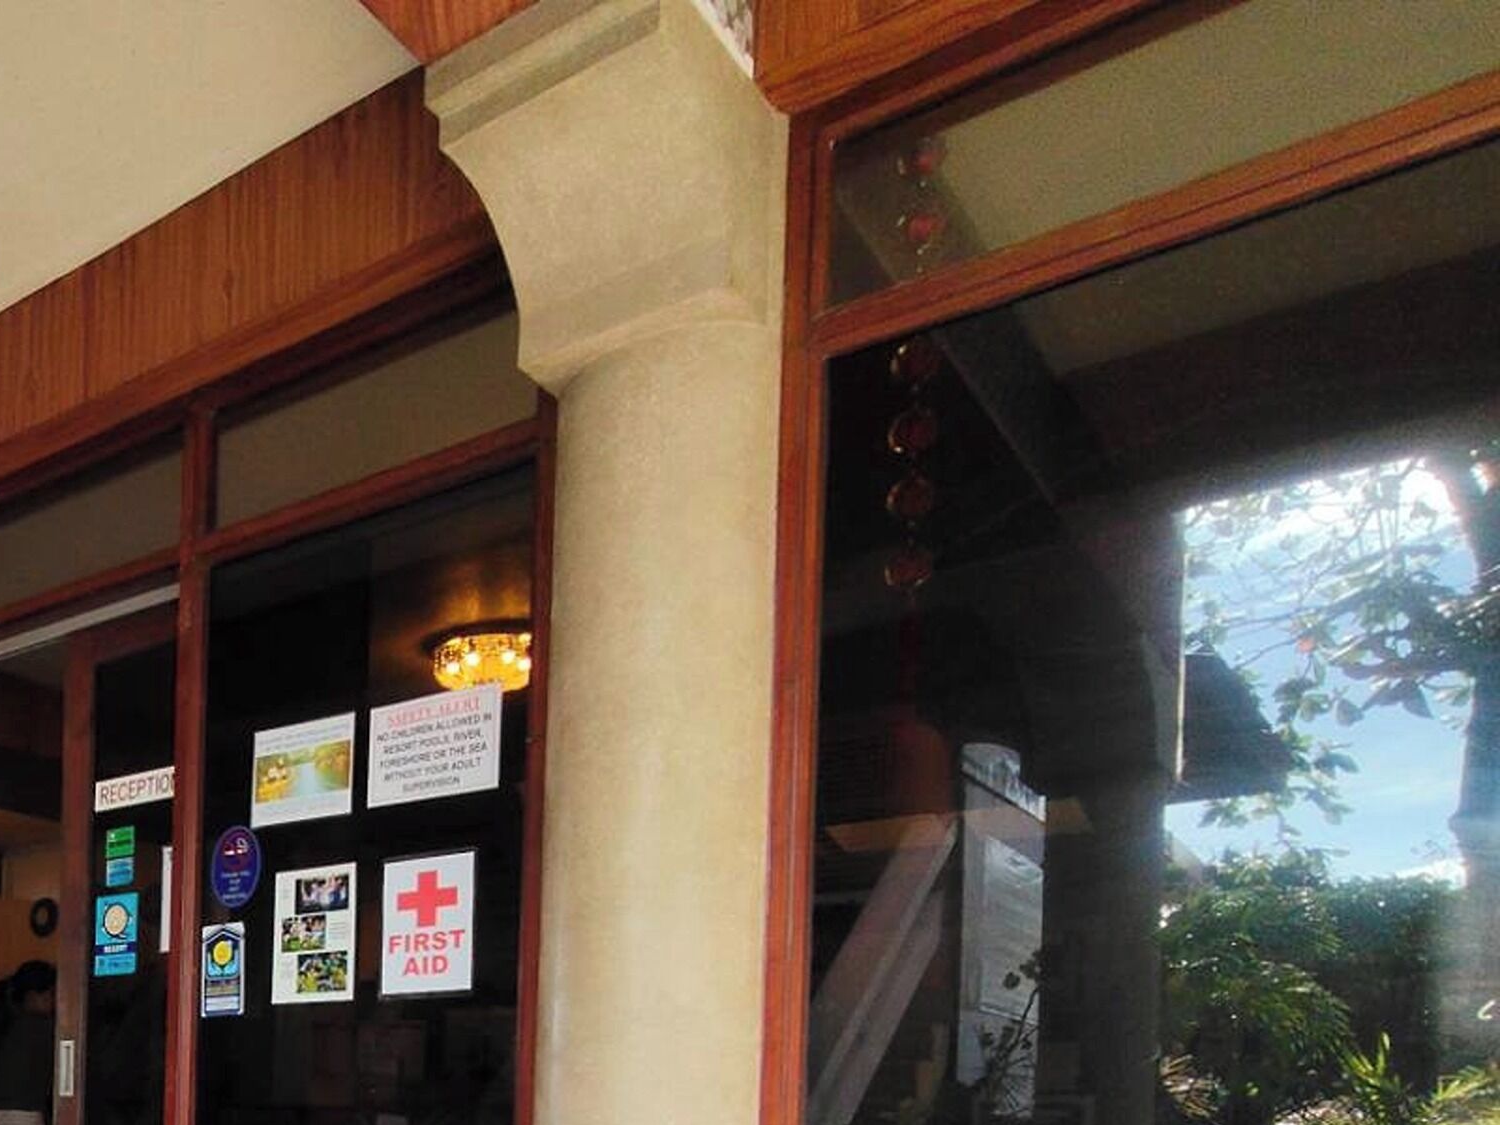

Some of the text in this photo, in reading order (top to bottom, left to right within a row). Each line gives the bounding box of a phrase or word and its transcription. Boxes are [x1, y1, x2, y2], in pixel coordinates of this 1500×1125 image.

[377, 713, 492, 742] NO CHILDREN ALLOWED IN
[380, 741, 487, 769] FORESHORE OR THE SEA
[383, 740, 417, 755] RESORT
[384, 757, 481, 782] WITHOUT YOUR ADULT
[403, 776, 461, 792] SUPERVISION
[388, 929, 465, 953] FIRST
[403, 956, 449, 976] AID
